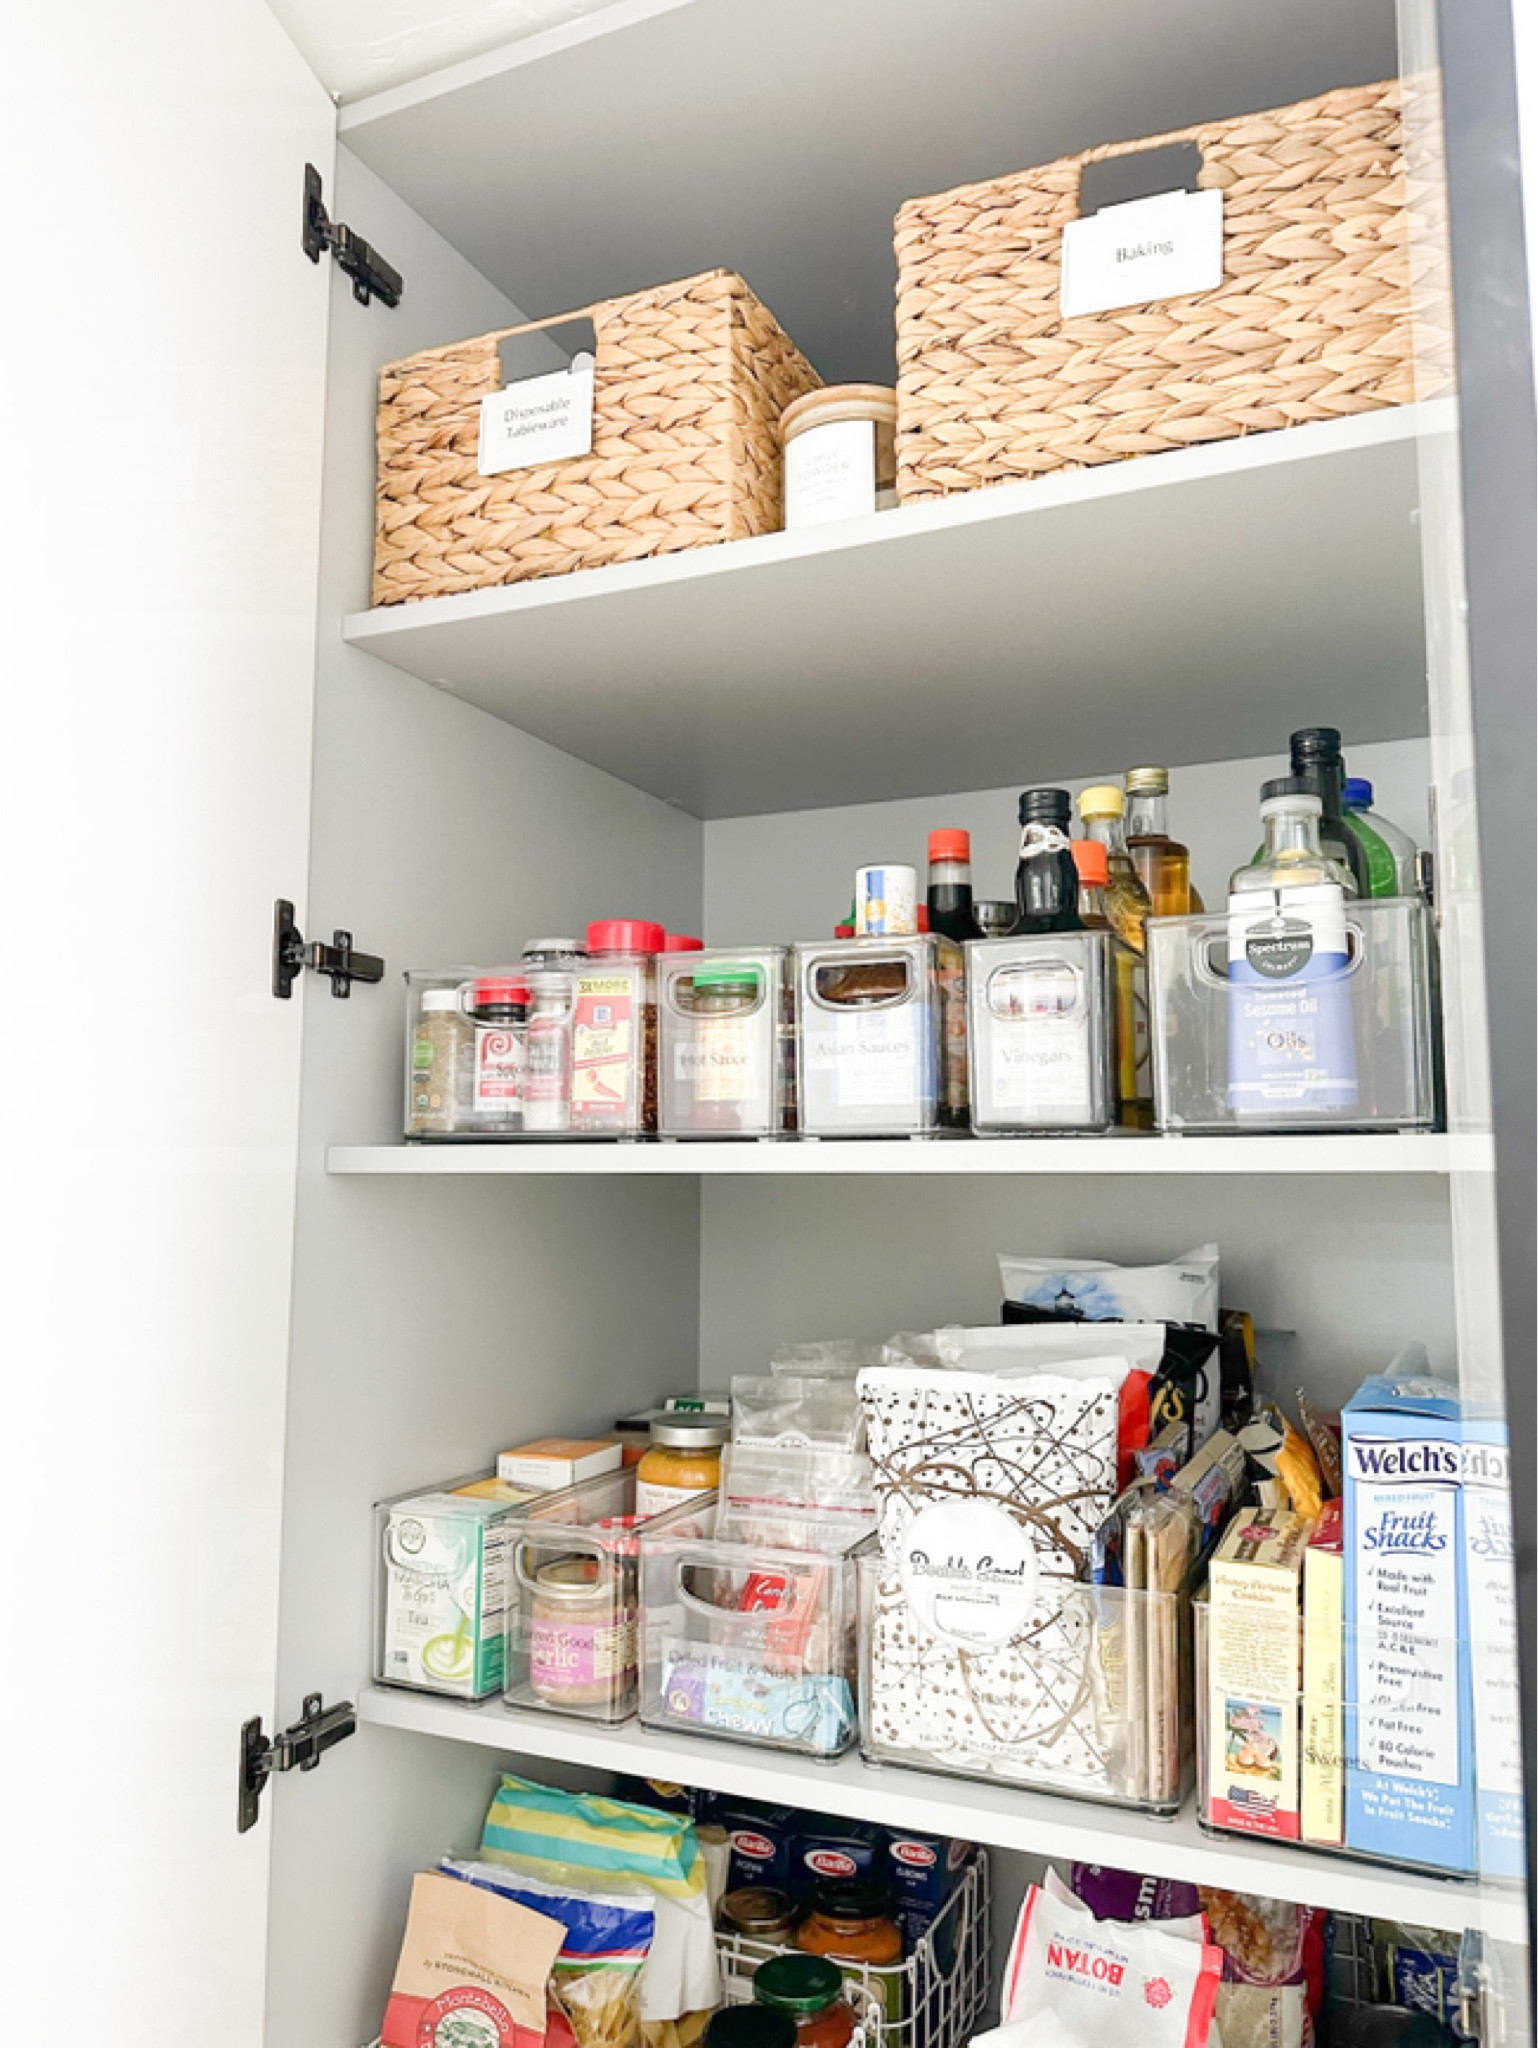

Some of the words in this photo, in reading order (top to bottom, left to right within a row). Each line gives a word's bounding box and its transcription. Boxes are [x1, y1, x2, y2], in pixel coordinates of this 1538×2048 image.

[1115, 240, 1174, 264] Baking
[503, 397, 571, 422] Disposable
[507, 416, 569, 438] Tableware
[1243, 1002, 1297, 1018] Sesame
[1299, 997, 1318, 1014] Oil
[816, 1042, 854, 1056] Asian
[1000, 1047, 1072, 1067] Vinegars
[1353, 1445, 1458, 1474] Welch's
[1381, 1511, 1438, 1531] Fruit
[1362, 1526, 1448, 1551] Snacks
[909, 1549, 973, 1580] Double
[1377, 1567, 1407, 1582] Made
[1411, 1572, 1436, 1585] with
[1377, 1580, 1400, 1593] Real
[1403, 1583, 1428, 1597] Fruit
[408, 1609, 429, 1627] Tea
[1377, 1602, 1425, 1618] Excellent
[1377, 1614, 1414, 1630] Source
[1377, 1661, 1444, 1682] Preservative
[1377, 1673, 1403, 1689] Free
[1416, 1702, 1441, 1716] Free
[1378, 1718, 1396, 1730] Fat
[1397, 1721, 1423, 1735] Free
[1378, 1739, 1394, 1752] 80
[1395, 1741, 1436, 1759] Calorie
[1378, 1754, 1422, 1772] Pouches
[1375, 1779, 1389, 1790] At
[1361, 1789, 1380, 1802] We
[1380, 1791, 1401, 1806] Put
[1404, 1796, 1425, 1811] The
[1427, 1801, 1455, 1817] Fruit
[1364, 1803, 1376, 1816] In
[1378, 1806, 1405, 1821] Fruit
[1047, 1942, 1125, 1987] BOTAN
